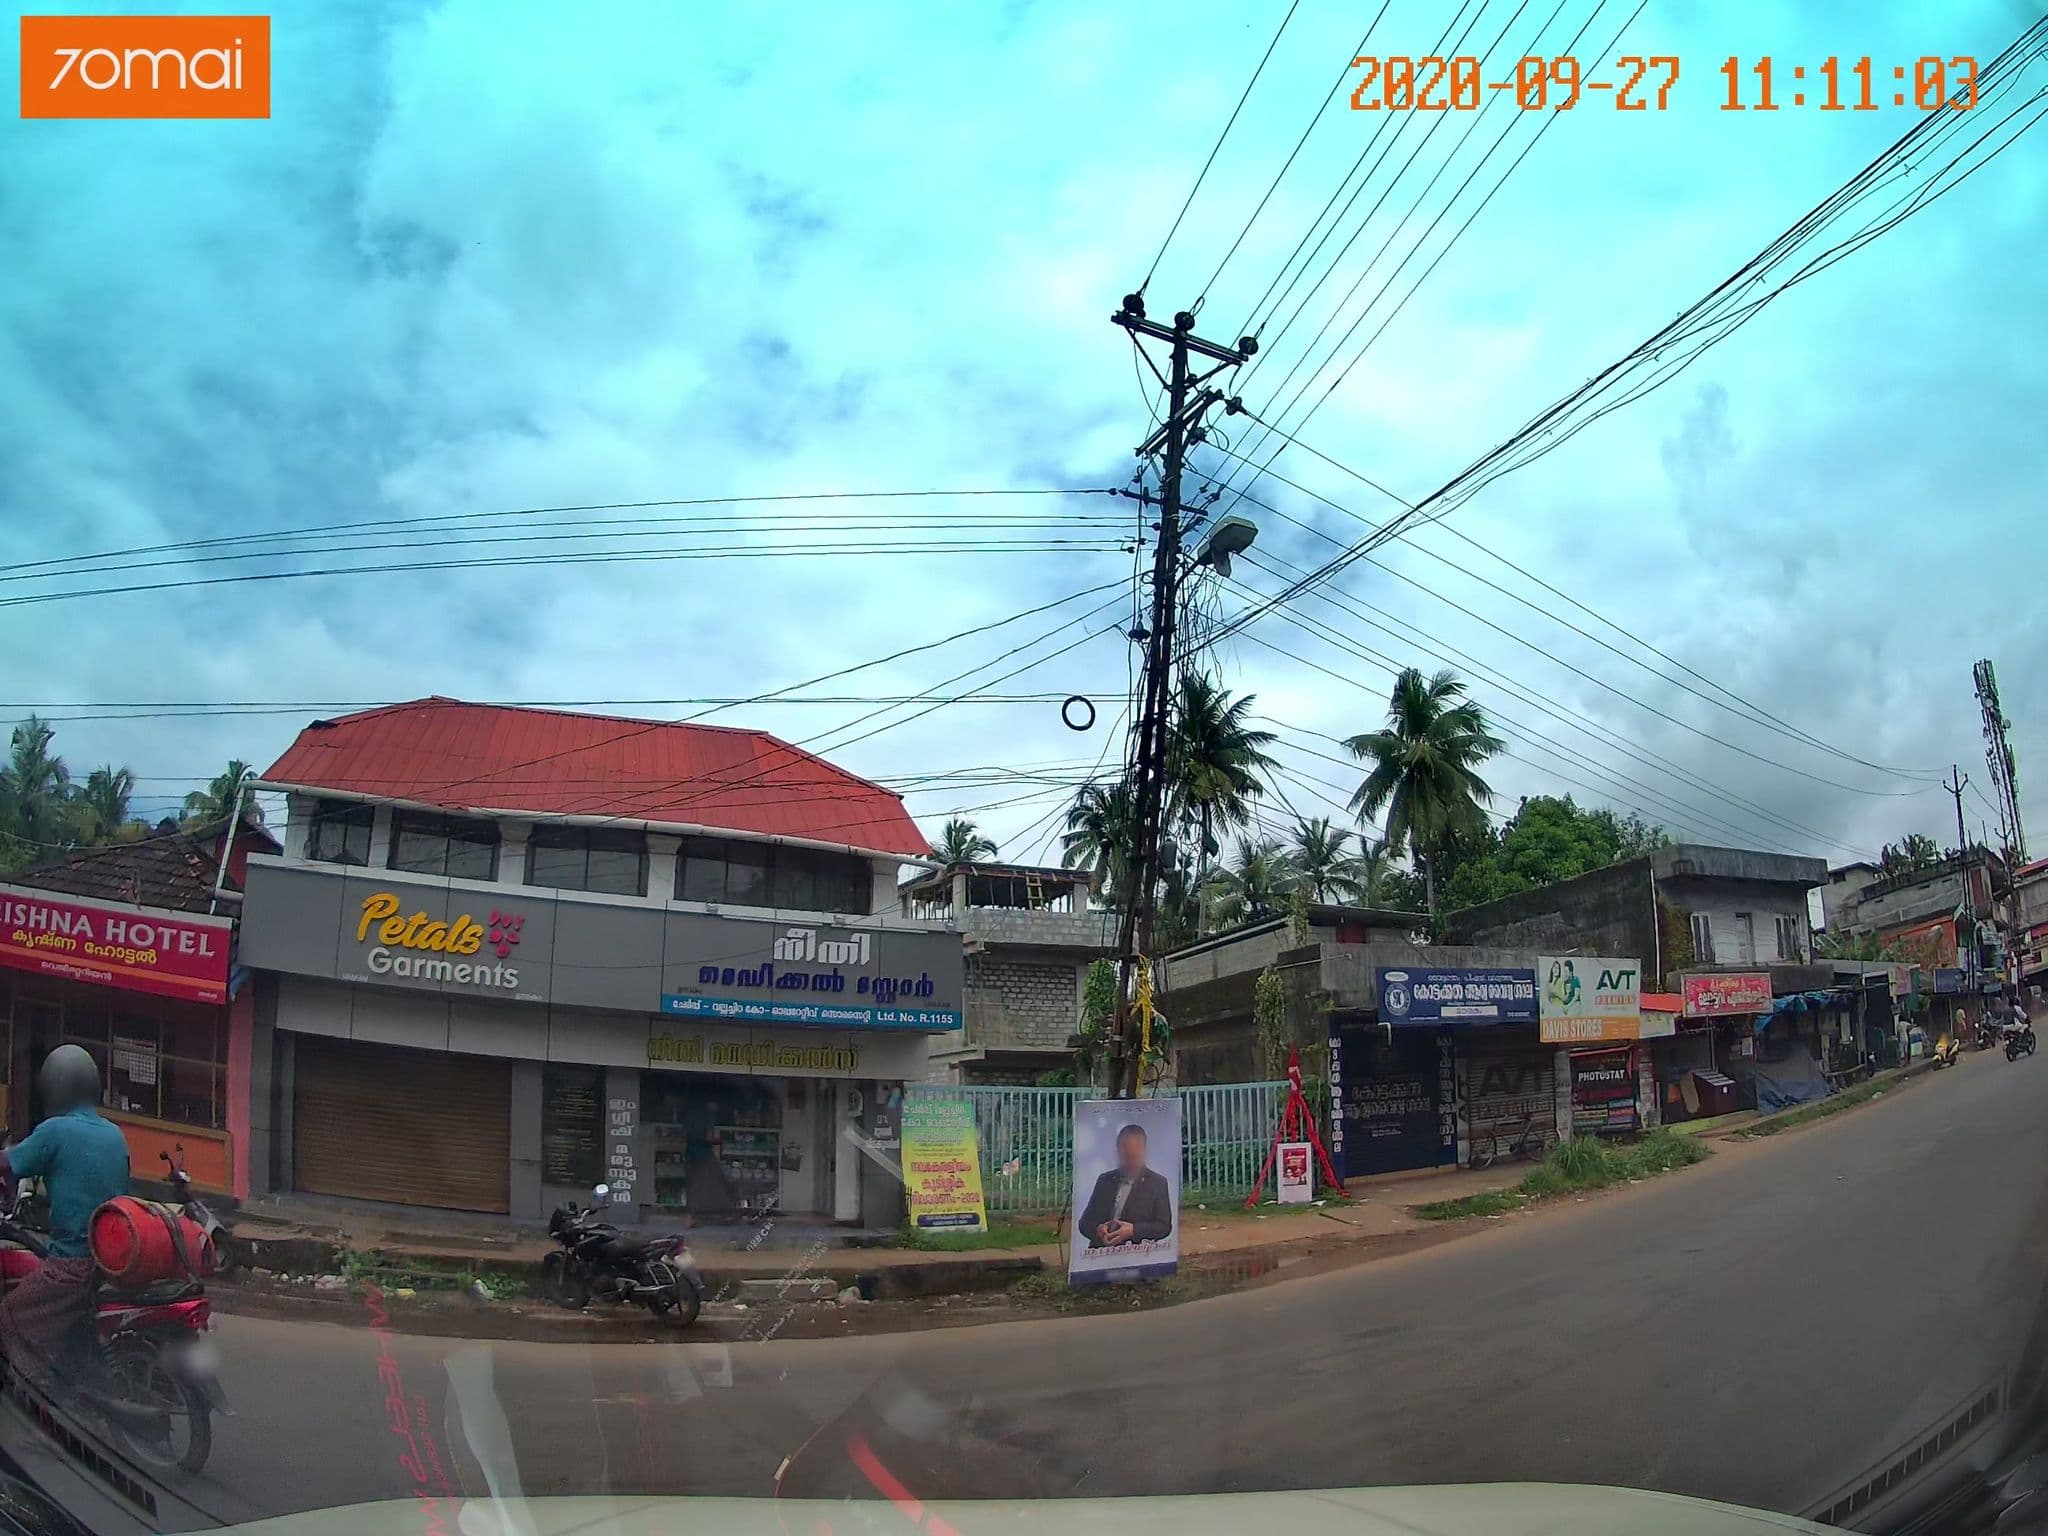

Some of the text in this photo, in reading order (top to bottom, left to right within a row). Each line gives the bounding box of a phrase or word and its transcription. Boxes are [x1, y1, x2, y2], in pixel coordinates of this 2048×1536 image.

[106, 918, 215, 957] HOTEL
[357, 892, 485, 954] Petals
[12, 929, 157, 965] കൃഷ്ണ ഹോട്ടൽ
[774, 927, 870, 965] നീതി
[367, 946, 519, 989] Garments
[1596, 969, 1636, 991] AVT
[877, 1011, 896, 1021] Ltd.
[900, 1012, 917, 1022] No.
[920, 1014, 953, 1024] R.1155
[1542, 1019, 1602, 1037] DAVIS STORES
[1578, 1069, 1625, 1082] PHOTOSTAT
